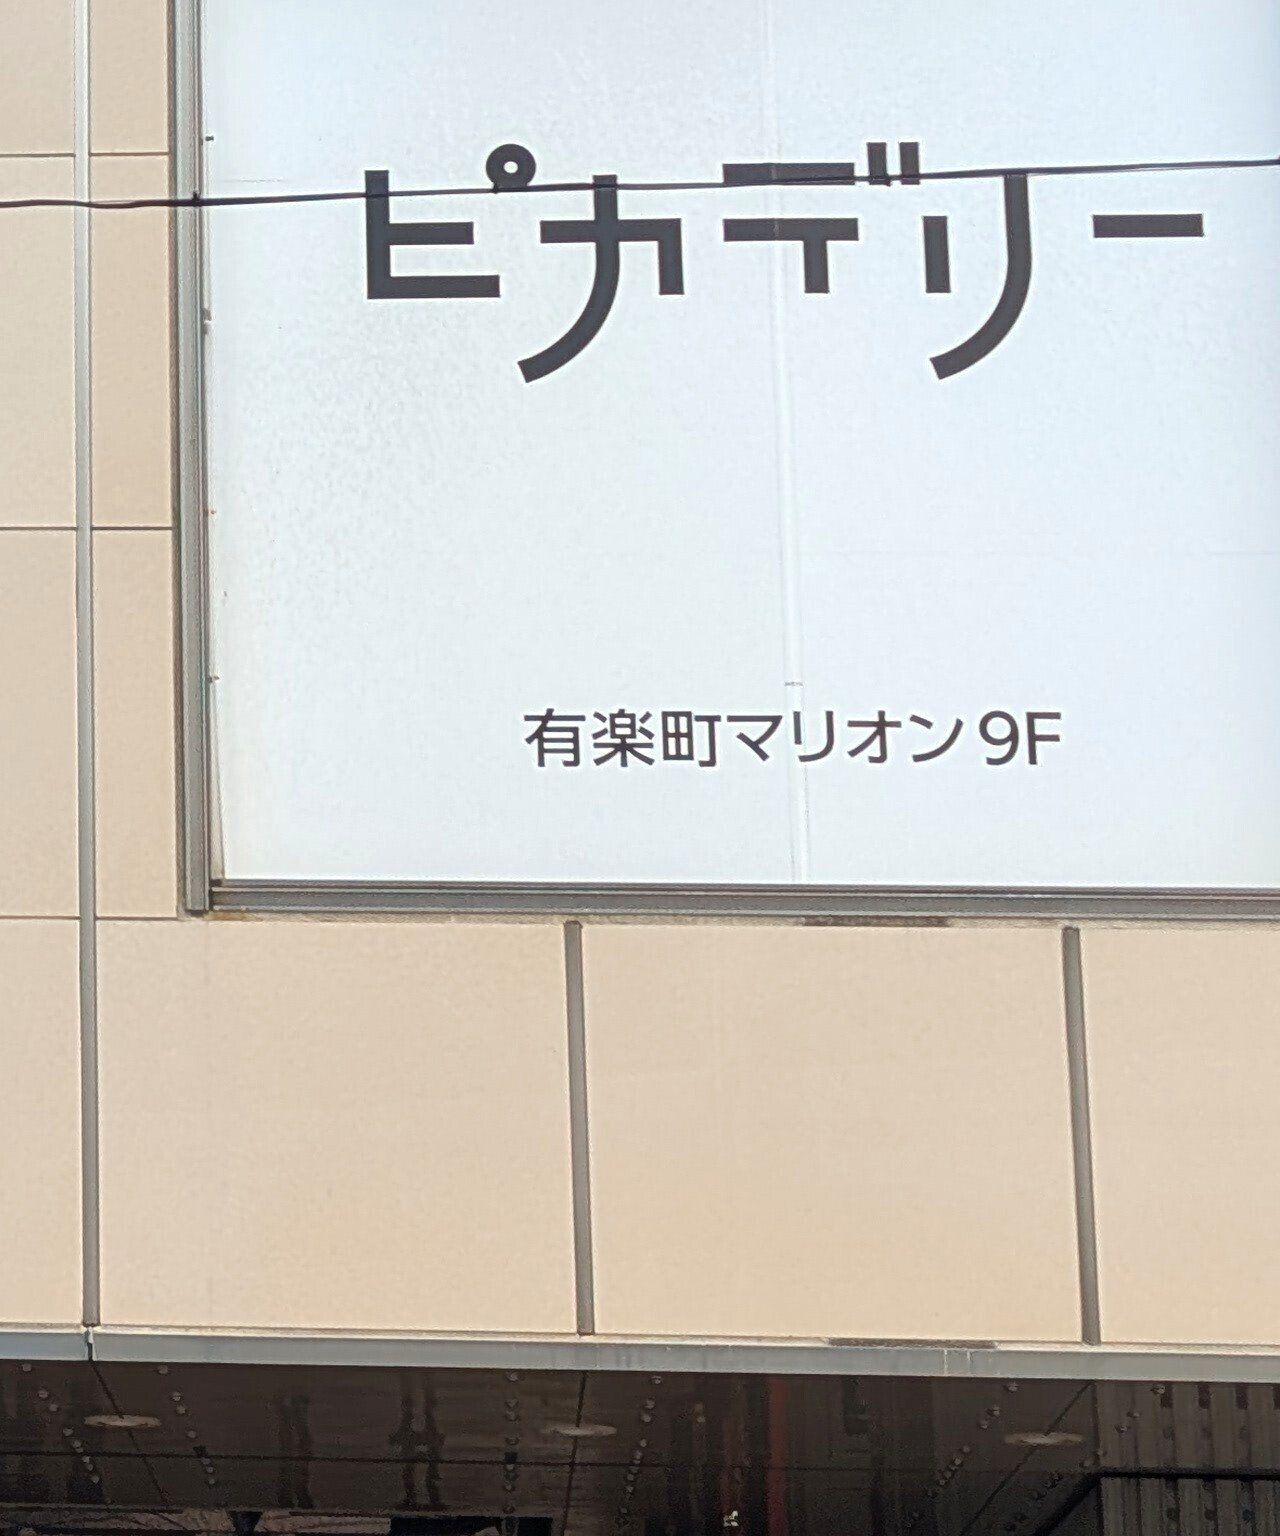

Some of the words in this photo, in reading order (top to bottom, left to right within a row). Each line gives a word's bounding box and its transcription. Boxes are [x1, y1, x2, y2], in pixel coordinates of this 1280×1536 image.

[365, 141, 1205, 383] ピカデリー
[523, 708, 1062, 768] 有楽町マリオン9F
